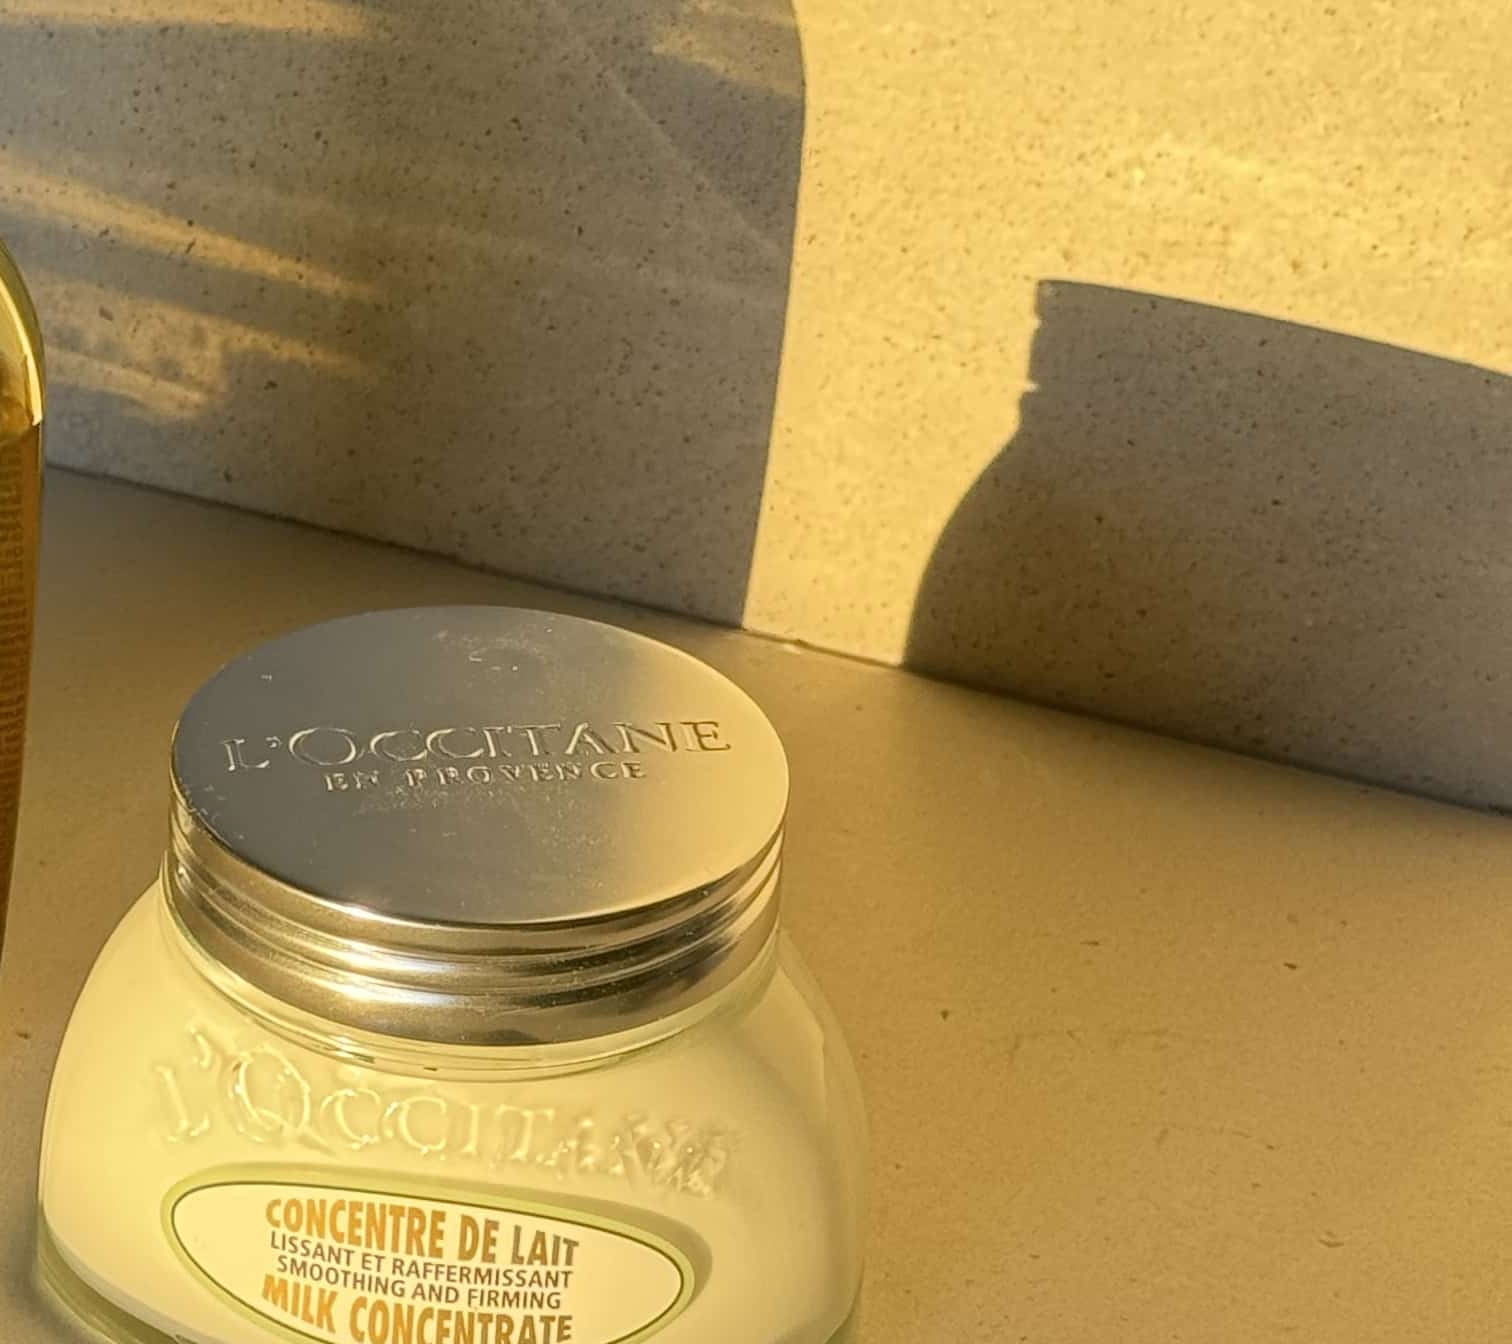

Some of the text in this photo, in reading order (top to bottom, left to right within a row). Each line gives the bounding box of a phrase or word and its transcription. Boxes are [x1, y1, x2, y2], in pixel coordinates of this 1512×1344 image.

[219, 721, 731, 772] L'OCCITANE
[325, 761, 647, 792] EN PROVENCE
[266, 1199, 579, 1267] CONCENTRE DE LAIT
[270, 1231, 573, 1289] LISSANT ET RAFFERMISSANT
[262, 1274, 338, 1334] MILK
[277, 1255, 561, 1310] SMOOTHING AND FIRMING
